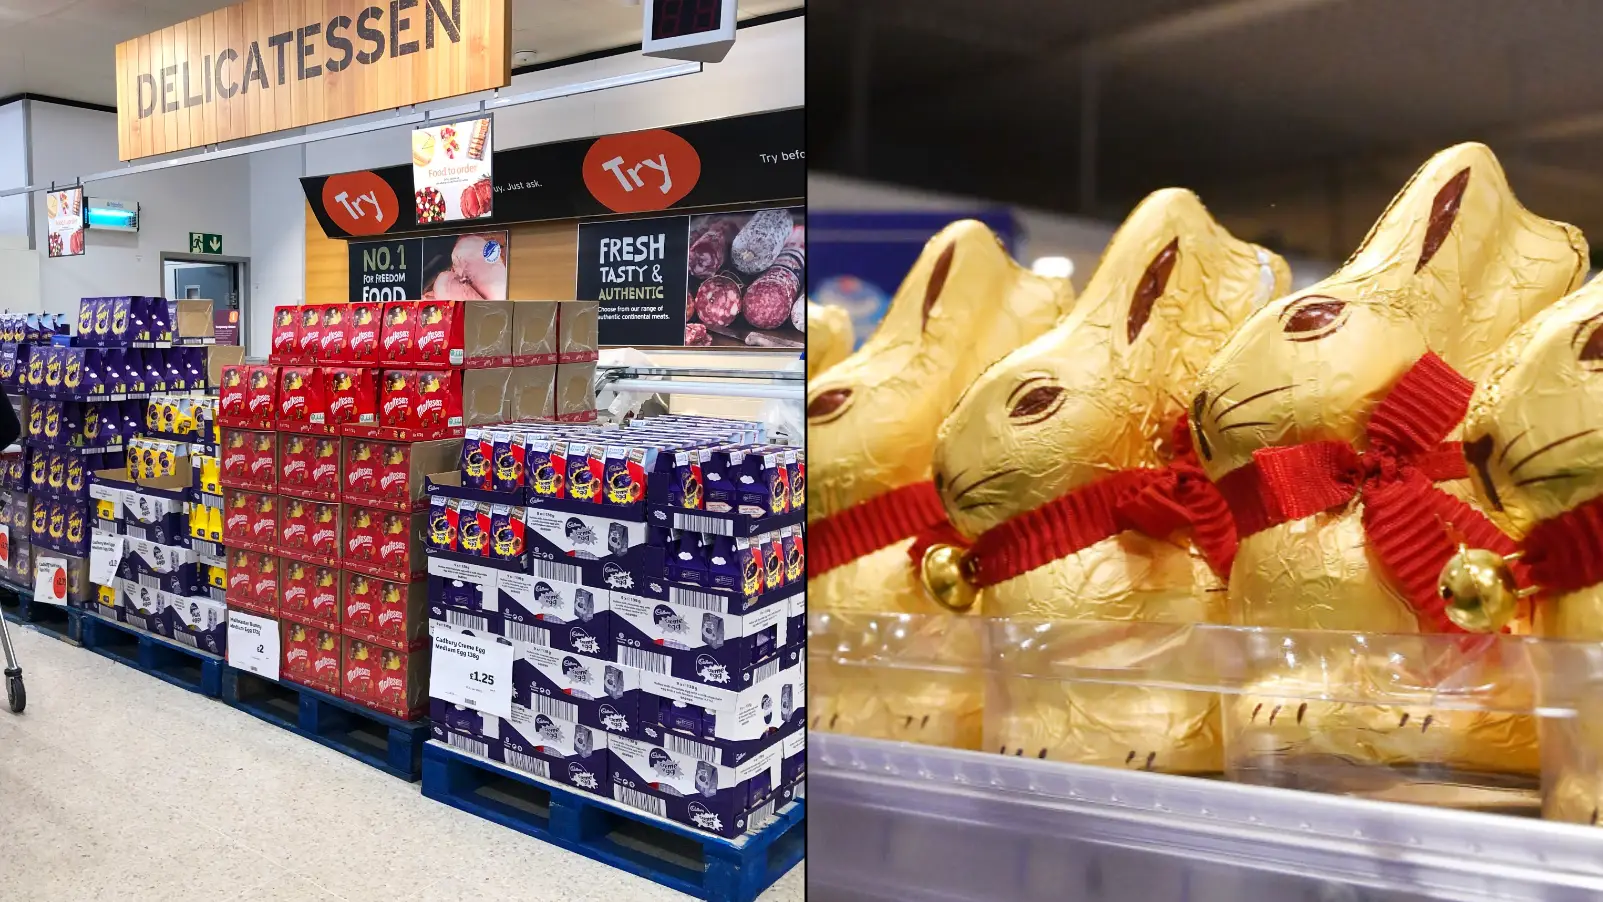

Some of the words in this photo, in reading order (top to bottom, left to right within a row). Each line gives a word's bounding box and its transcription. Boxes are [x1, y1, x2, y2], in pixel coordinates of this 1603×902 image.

[137, 0, 461, 119] DELICATESSEN
[759, 153, 778, 164] Try
[428, 168, 447, 178] Food
[447, 168, 456, 177] to
[457, 164, 478, 175] order
[601, 153, 673, 195] Try
[493, 186, 506, 194] uy.
[507, 182, 525, 192] Just
[526, 180, 543, 190] ask.
[334, 191, 384, 223] Try
[599, 233, 666, 264] FRESH
[363, 248, 395, 272] NO.
[397, 245, 407, 270] 1
[363, 274, 374, 284] FOR
[375, 272, 406, 283] FREEDOM
[599, 265, 650, 284] TASTY
[651, 264, 663, 284] &
[362, 285, 407, 302] FOOD
[598, 286, 664, 301] AUTHENTIC
[257, 644, 264, 654] £2
[435, 637, 457, 648] Cadbury
[457, 642, 475, 651] Creme
[475, 645, 486, 654] Egg
[435, 644, 456, 653] Medium
[456, 649, 467, 658] Egg
[467, 652, 480, 660] 138g
[469, 671, 494, 685] £1.25
